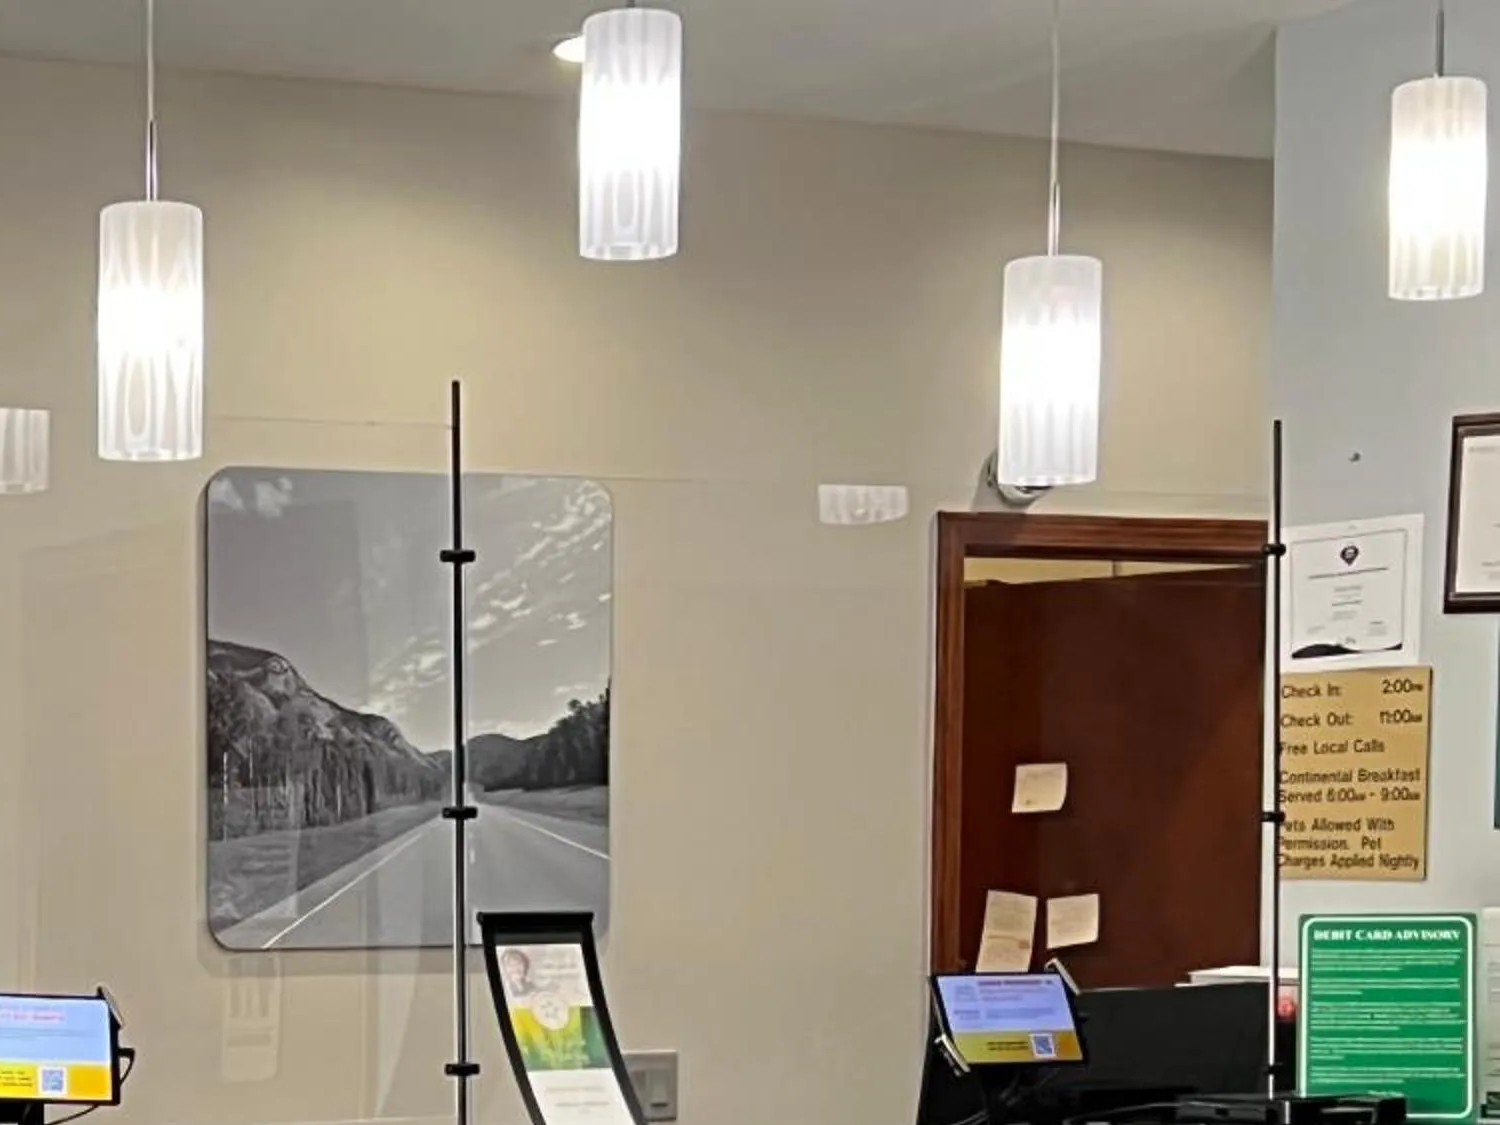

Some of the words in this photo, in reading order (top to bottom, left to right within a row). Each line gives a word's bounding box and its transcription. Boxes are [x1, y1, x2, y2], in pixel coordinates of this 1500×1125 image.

[1282, 685, 1322, 699] Check
[1281, 713, 1321, 728] Check
[1313, 739, 1349, 755] Local
[1353, 738, 1385, 753] Calls
[1280, 770, 1353, 784] Continental
[1357, 767, 1421, 782] Breakfast
[1280, 819, 1306, 833] ets
[1311, 817, 1362, 832] Allowed
[1366, 817, 1395, 832] With
[1361, 835, 1381, 850] Pet
[1329, 852, 1374, 869] Applied
[1380, 852, 1418, 871] Nightly
[1313, 929, 1352, 941] DEBIT
[1355, 929, 1393, 941] CARD
[1396, 928, 1461, 941] ADVISORY
